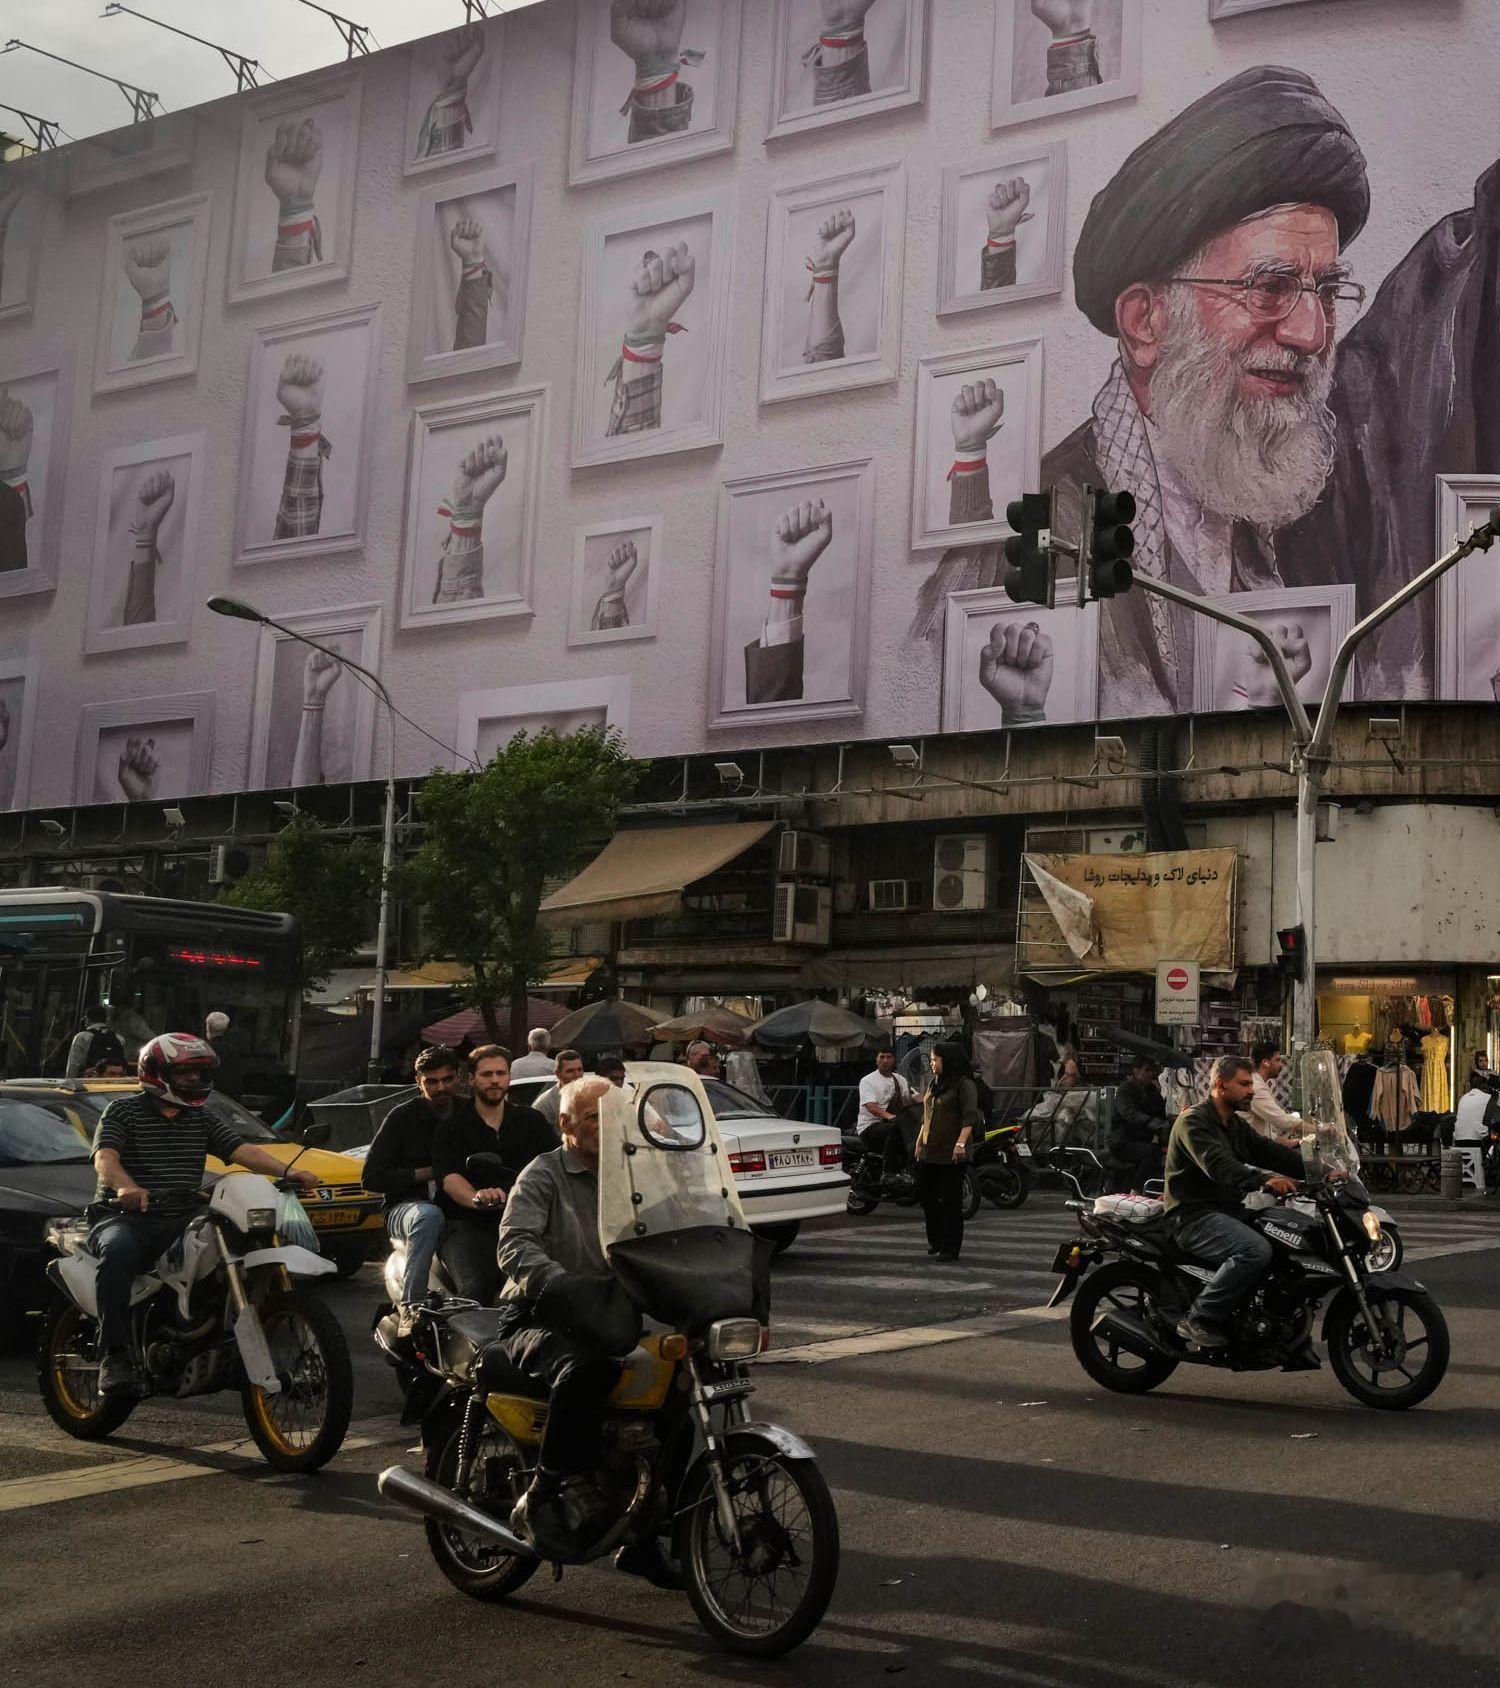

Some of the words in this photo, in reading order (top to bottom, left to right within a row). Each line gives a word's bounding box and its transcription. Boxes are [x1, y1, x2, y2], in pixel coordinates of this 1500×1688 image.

[1153, 873, 1160, 887] و
[1163, 866, 1184, 882] لاک
[1187, 865, 1219, 885] دنیای
[1263, 1222, 1303, 1246] Benelli
